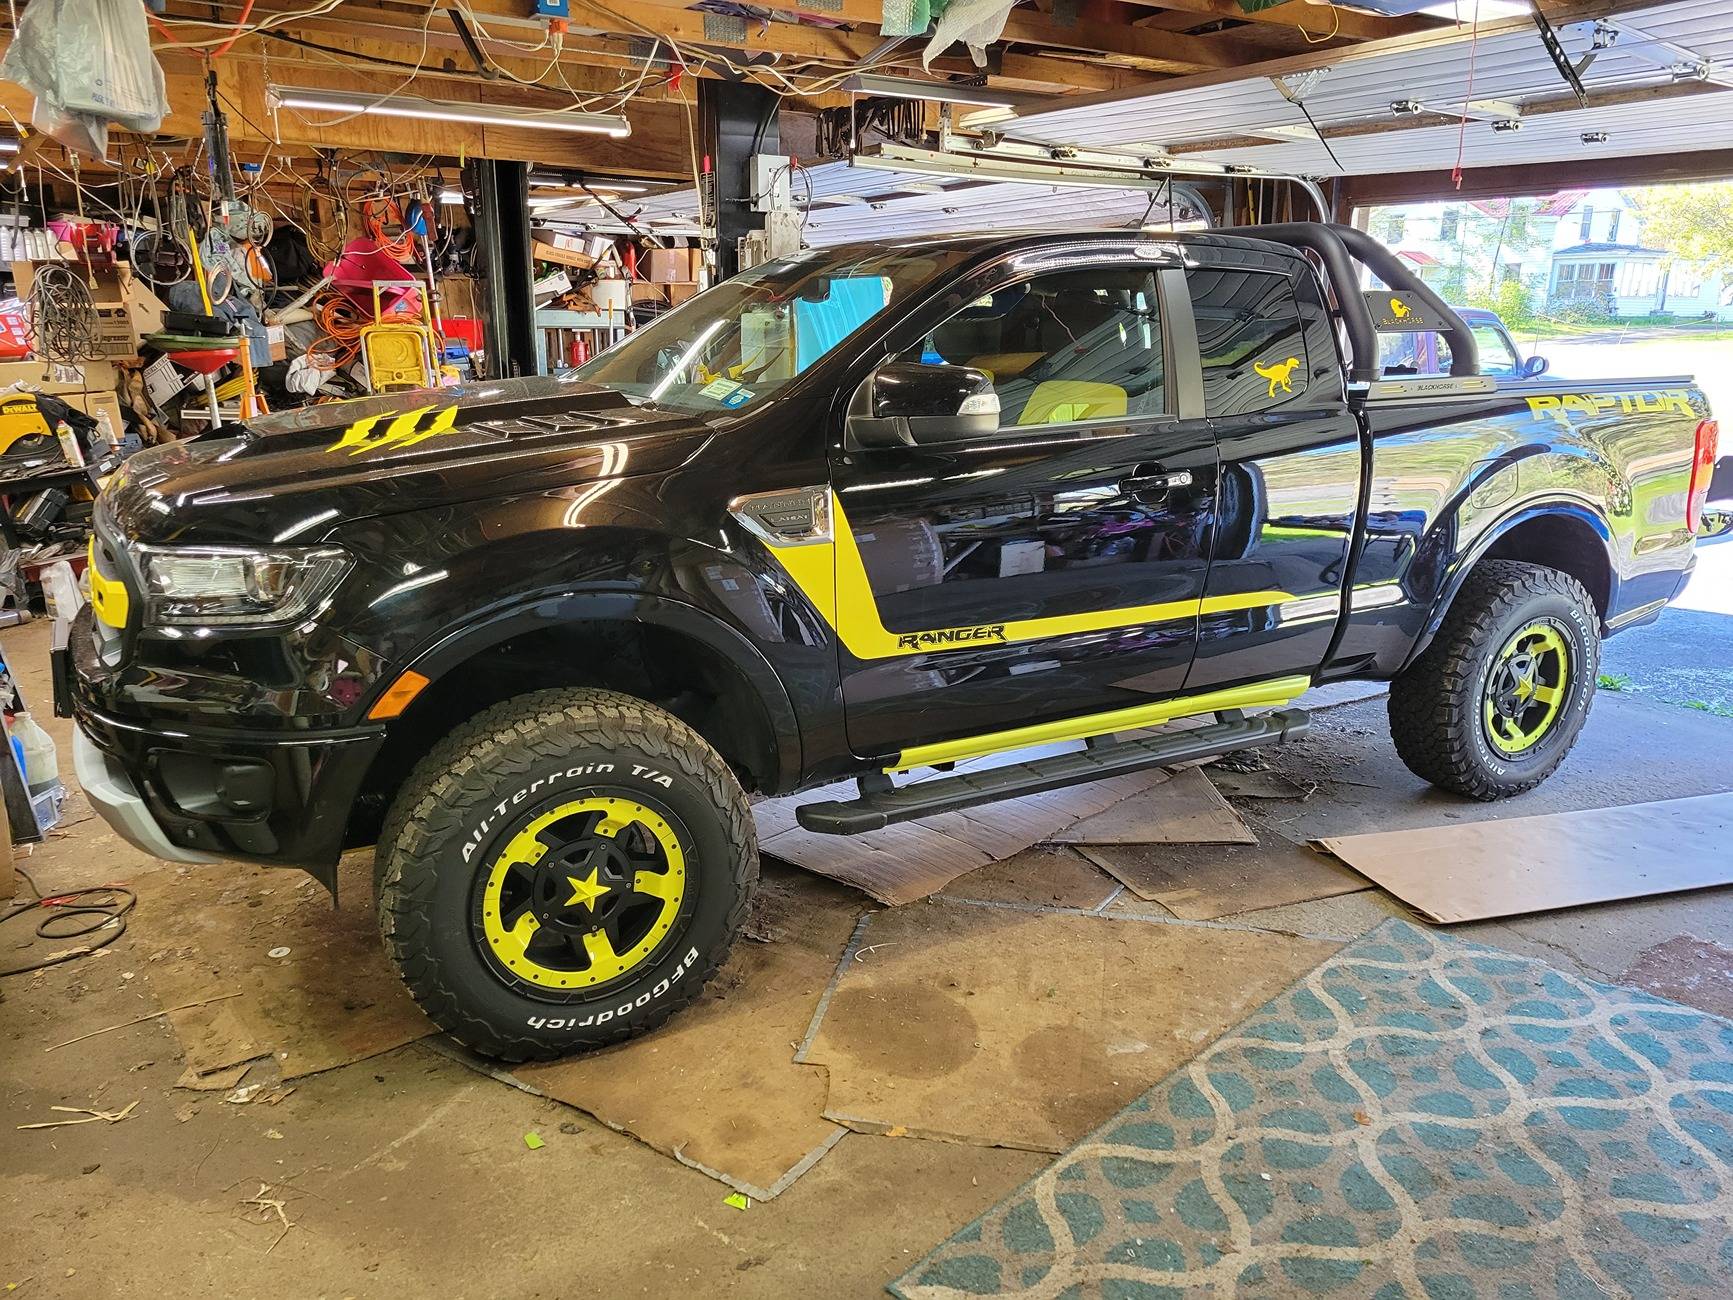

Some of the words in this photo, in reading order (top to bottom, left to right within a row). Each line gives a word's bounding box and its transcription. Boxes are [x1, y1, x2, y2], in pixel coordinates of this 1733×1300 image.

[1417, 383, 1454, 391] BLACKHORSE
[1525, 388, 1696, 430] RAPTOR
[898, 625, 1007, 650] RANGER
[1570, 609, 1593, 711] BFGoodrich
[461, 762, 616, 863] All-Terrain
[631, 764, 674, 789] T/A
[527, 946, 700, 1031] BFGoodrich
